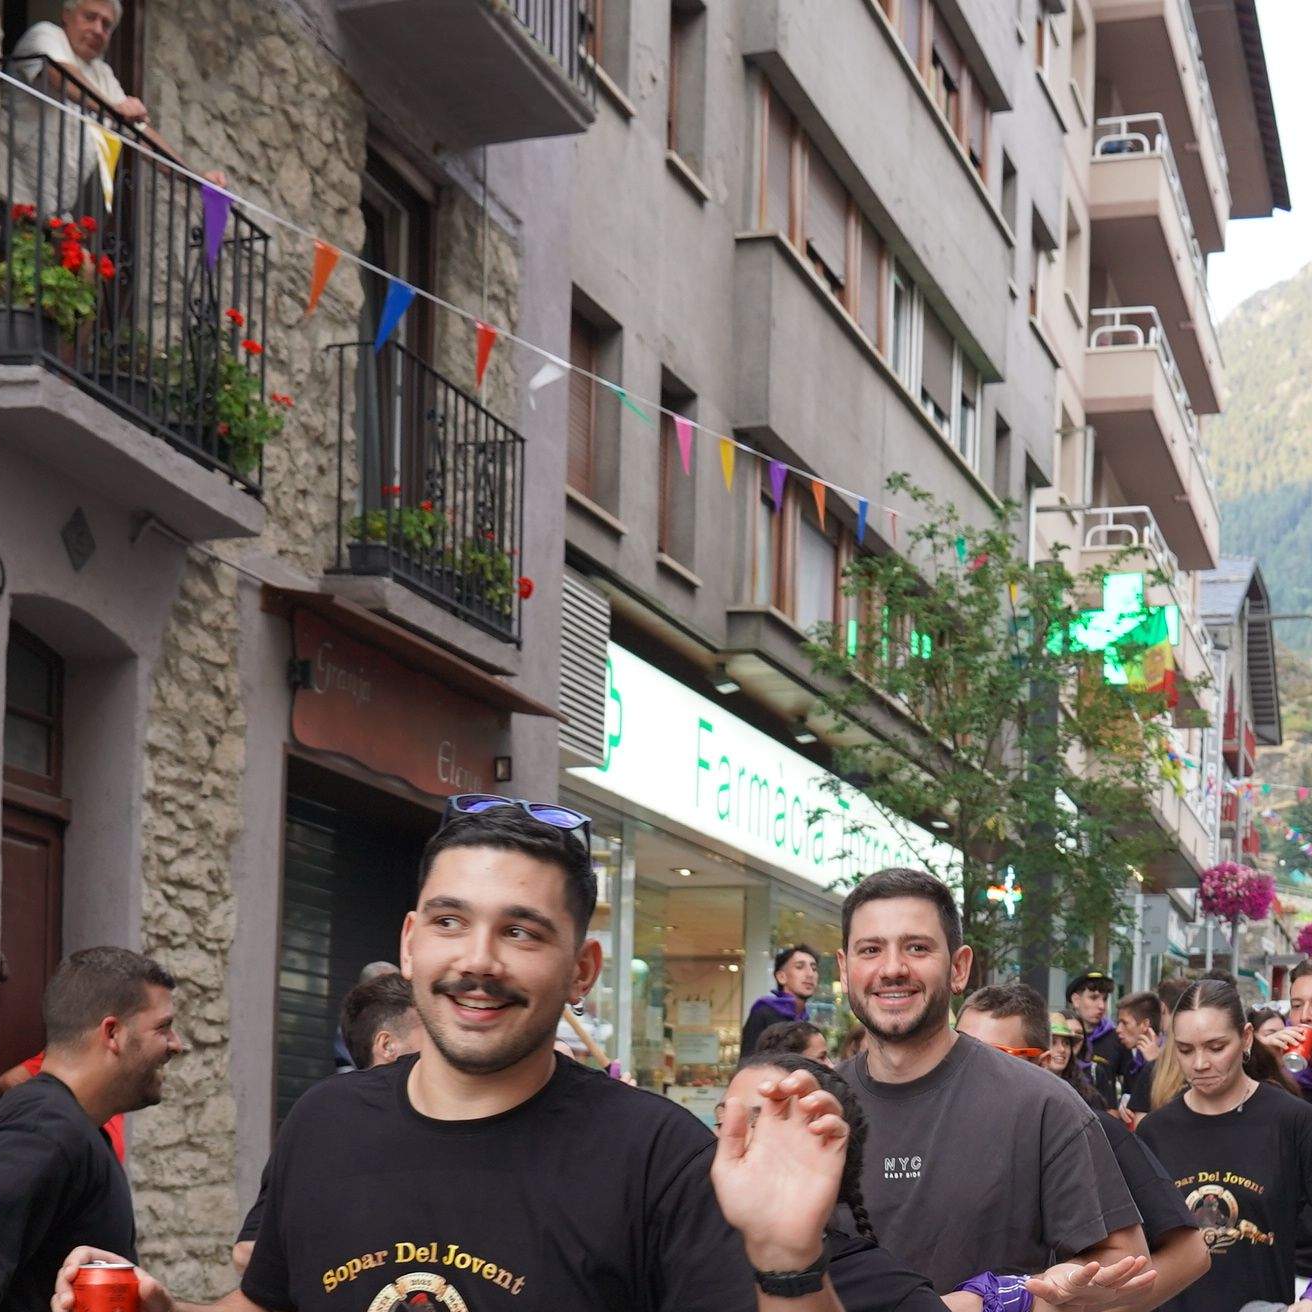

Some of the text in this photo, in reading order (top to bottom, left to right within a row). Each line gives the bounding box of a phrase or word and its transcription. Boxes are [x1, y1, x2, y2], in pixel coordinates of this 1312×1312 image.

[884, 1156, 922, 1171] NYC
[1198, 1171, 1220, 1183] Del
[1223, 1172, 1265, 1195] Jovent
[322, 1242, 526, 1296] Sopar Del Jovent
